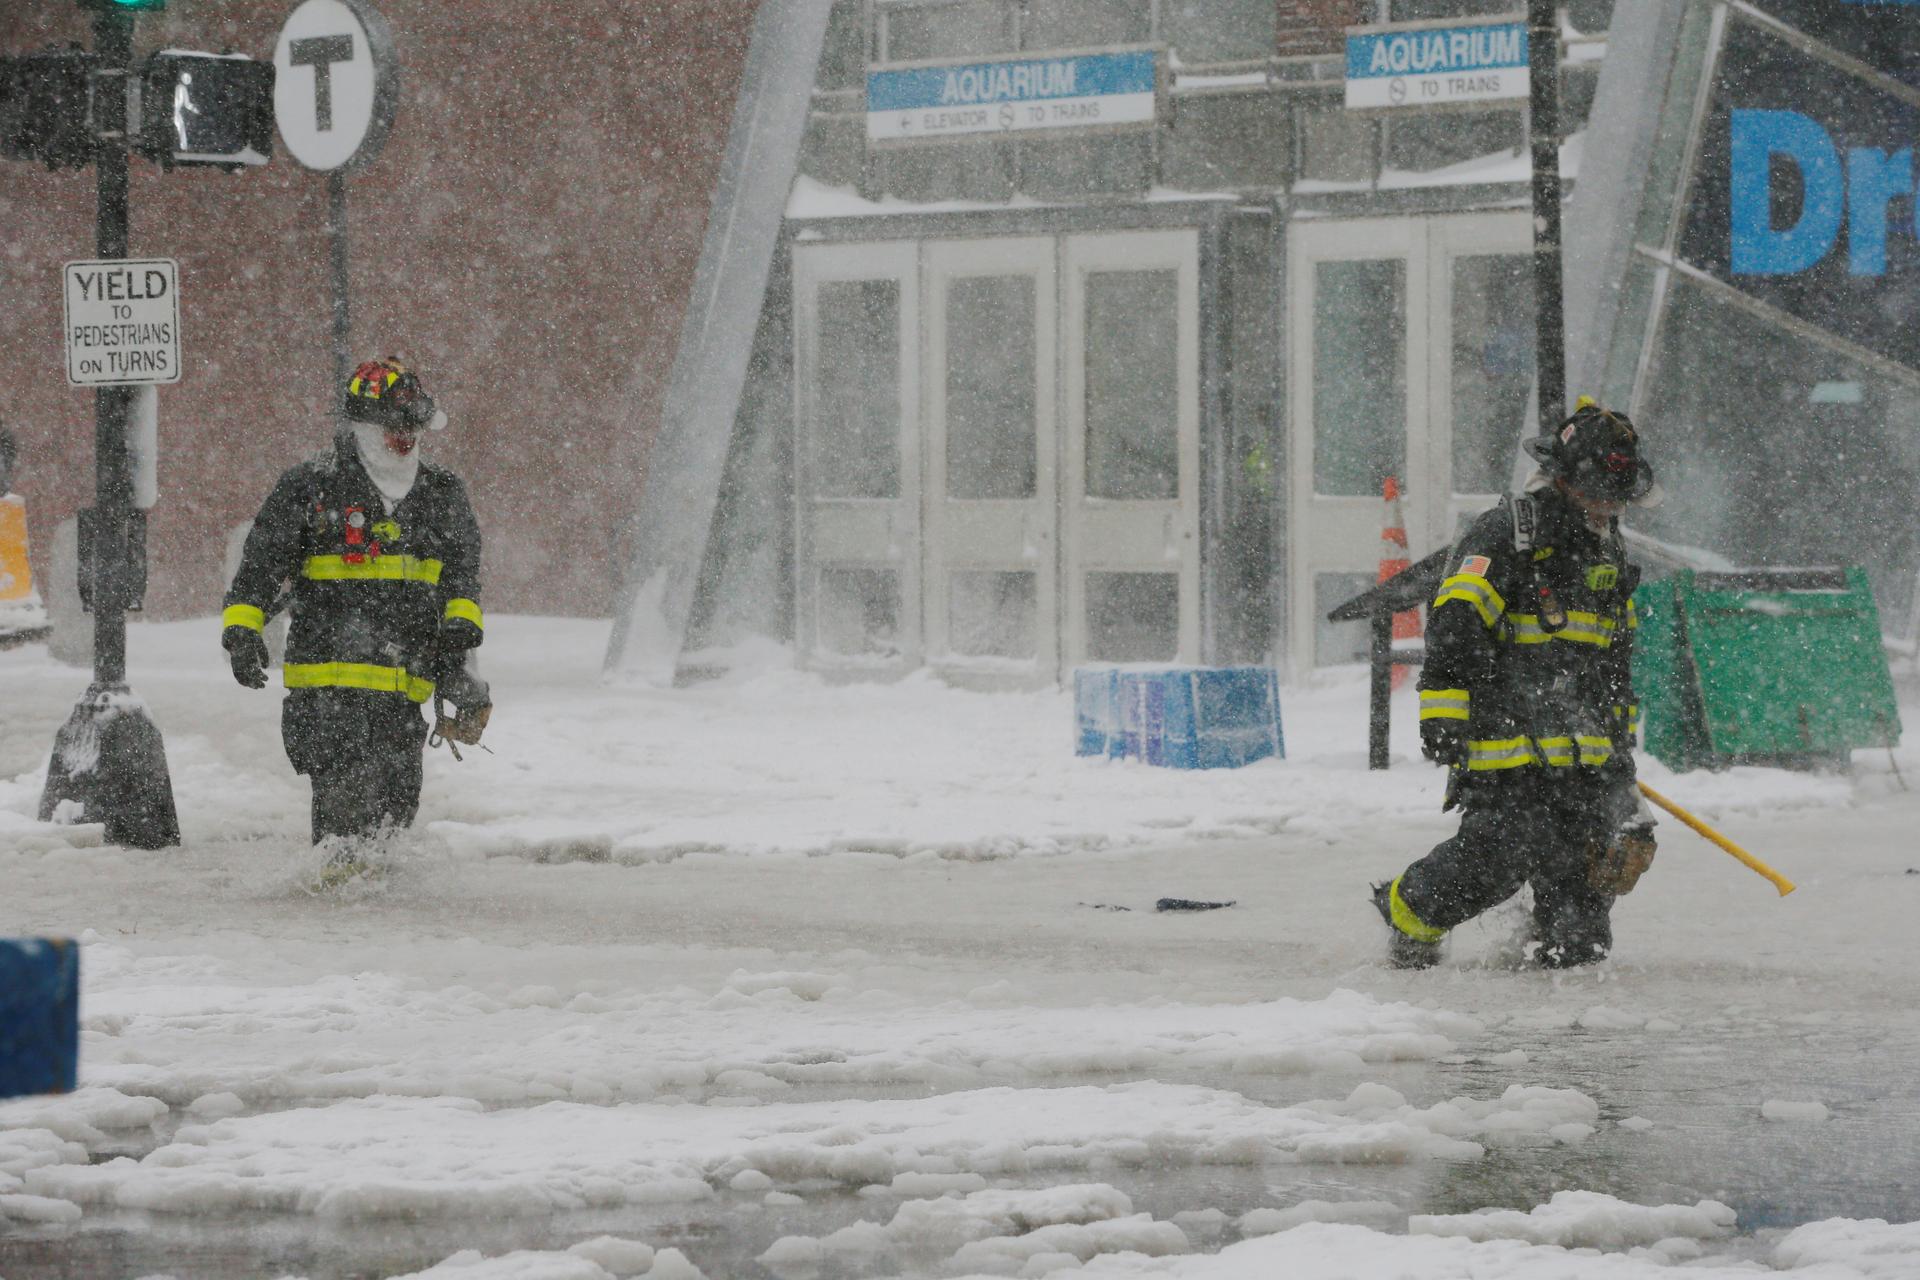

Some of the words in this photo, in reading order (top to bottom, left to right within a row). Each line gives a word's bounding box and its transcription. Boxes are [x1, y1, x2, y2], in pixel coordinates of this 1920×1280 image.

[1371, 30, 1520, 73] AQUARIUM
[290, 34, 354, 132] T
[943, 62, 1076, 101] AQUARIUM
[1421, 79, 1439, 97] TO
[1448, 75, 1500, 95] TRAINS
[924, 110, 988, 130] ELEVATOR
[1027, 106, 1045, 122] TO
[1730, 108, 1920, 276] Dr
[74, 270, 167, 300] YIELD
[112, 305, 132, 319] TO
[74, 323, 170, 347] PEDESTRIANS
[80, 360, 102, 374] ON
[107, 350, 167, 372] TURNS
